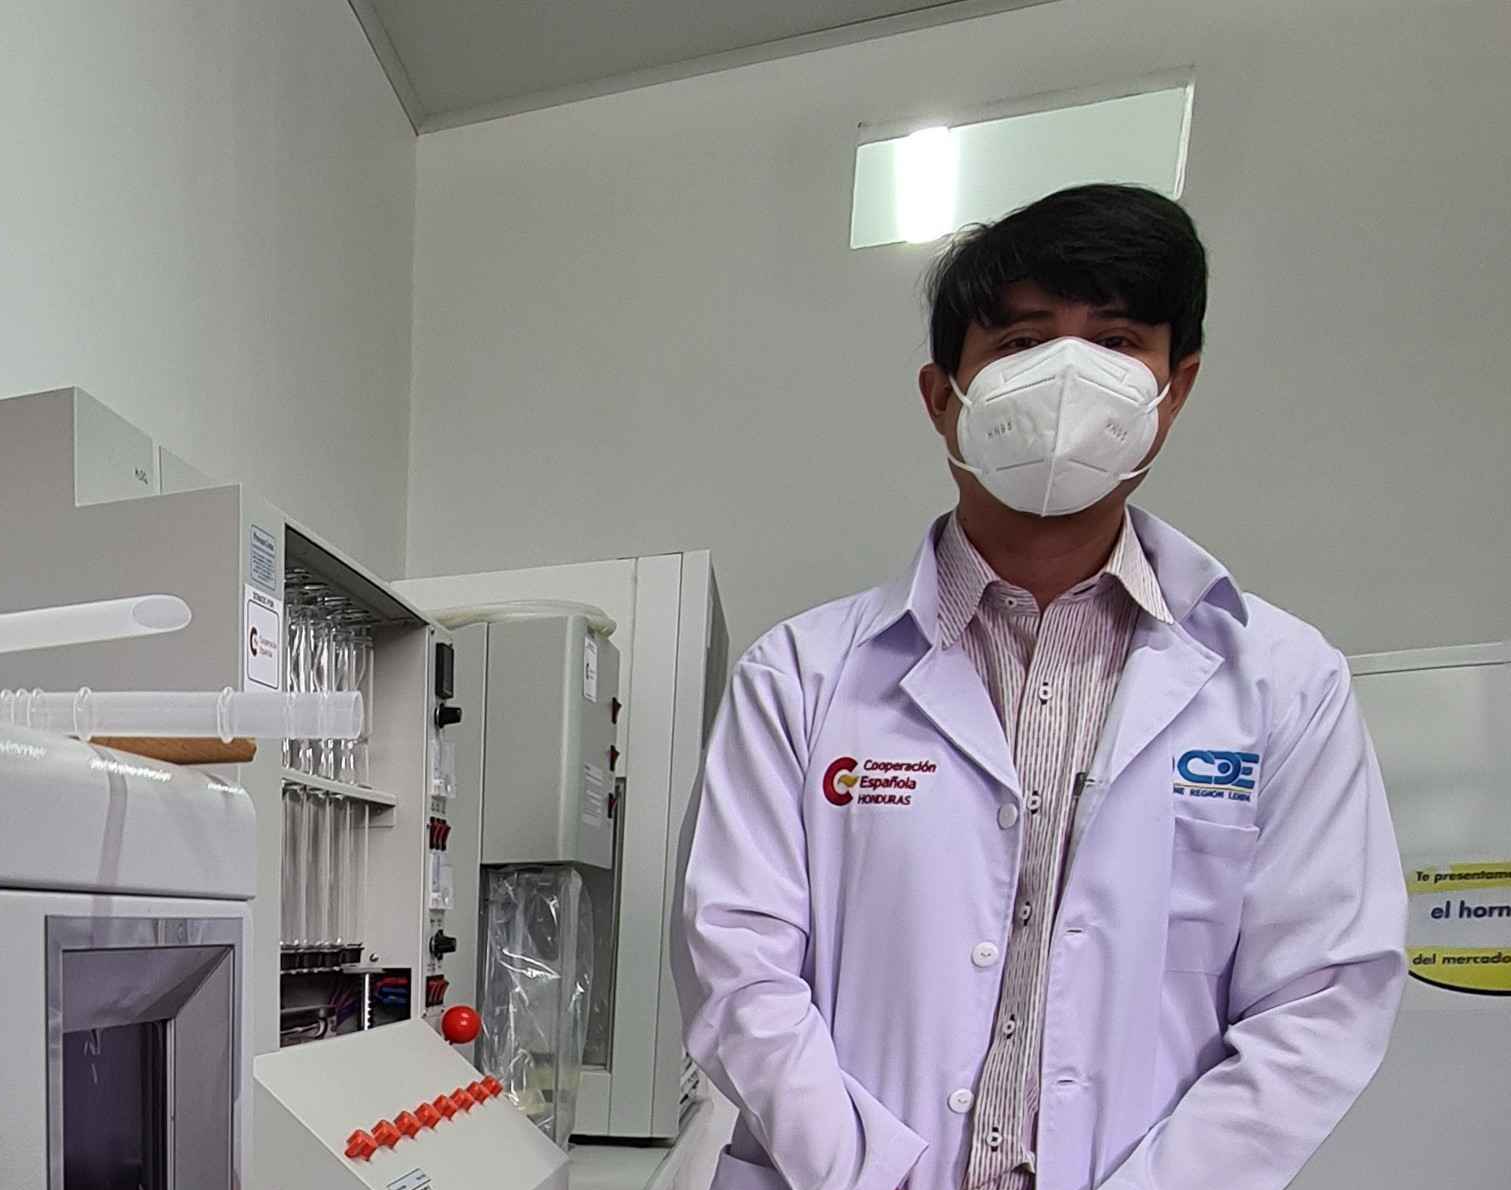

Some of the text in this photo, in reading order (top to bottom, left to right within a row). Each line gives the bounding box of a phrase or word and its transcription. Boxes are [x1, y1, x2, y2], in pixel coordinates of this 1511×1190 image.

[863, 760, 937, 773] Cooperación
[859, 776, 917, 790] Española
[857, 794, 912, 805] HONDURAS
[1416, 871, 1430, 882] Te
[1431, 900, 1451, 919] el
[1412, 951, 1511, 965] del mercado
